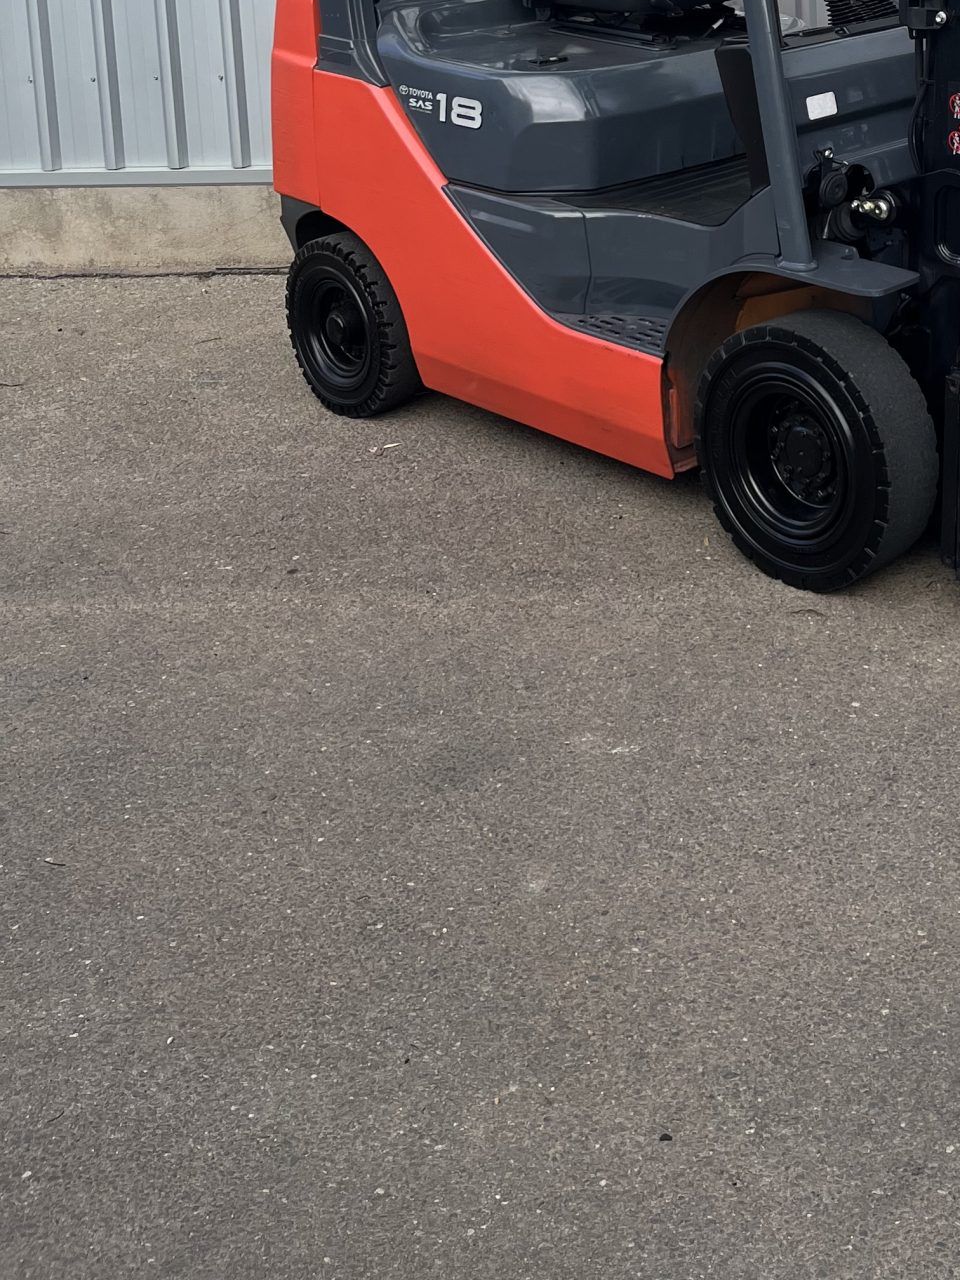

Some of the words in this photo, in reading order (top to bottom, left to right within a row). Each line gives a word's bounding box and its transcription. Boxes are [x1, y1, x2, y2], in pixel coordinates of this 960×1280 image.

[409, 87, 433, 99] TOYOTA
[408, 98, 433, 110] SAS
[435, 92, 483, 129] 18
